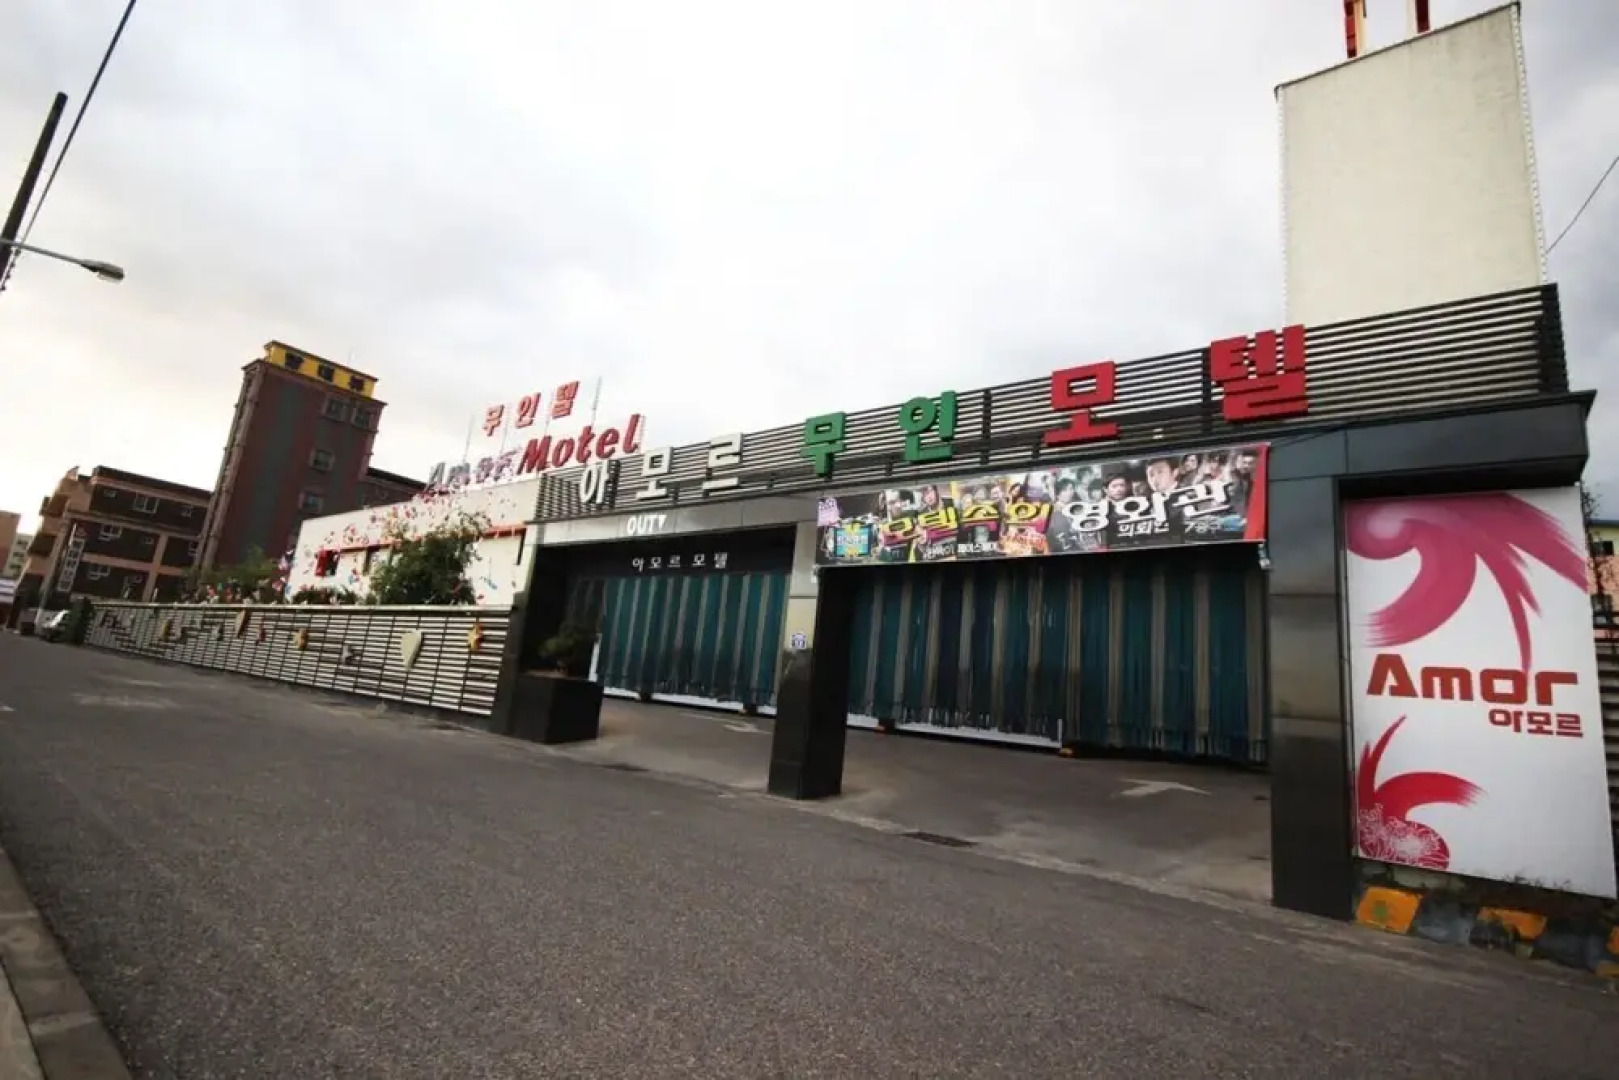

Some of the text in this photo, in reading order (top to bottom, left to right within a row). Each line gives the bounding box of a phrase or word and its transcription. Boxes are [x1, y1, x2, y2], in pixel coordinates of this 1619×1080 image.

[483, 381, 580, 437] 무인텔
[578, 324, 1308, 504] 아모르 무인 모텔
[516, 413, 643, 474] Motel
[627, 513, 656, 535] OUT
[1061, 479, 1233, 532] 영화관
[632, 555, 681, 572] 아모르
[1366, 653, 1579, 707] Amor
[1488, 708, 1584, 738] 아모르
